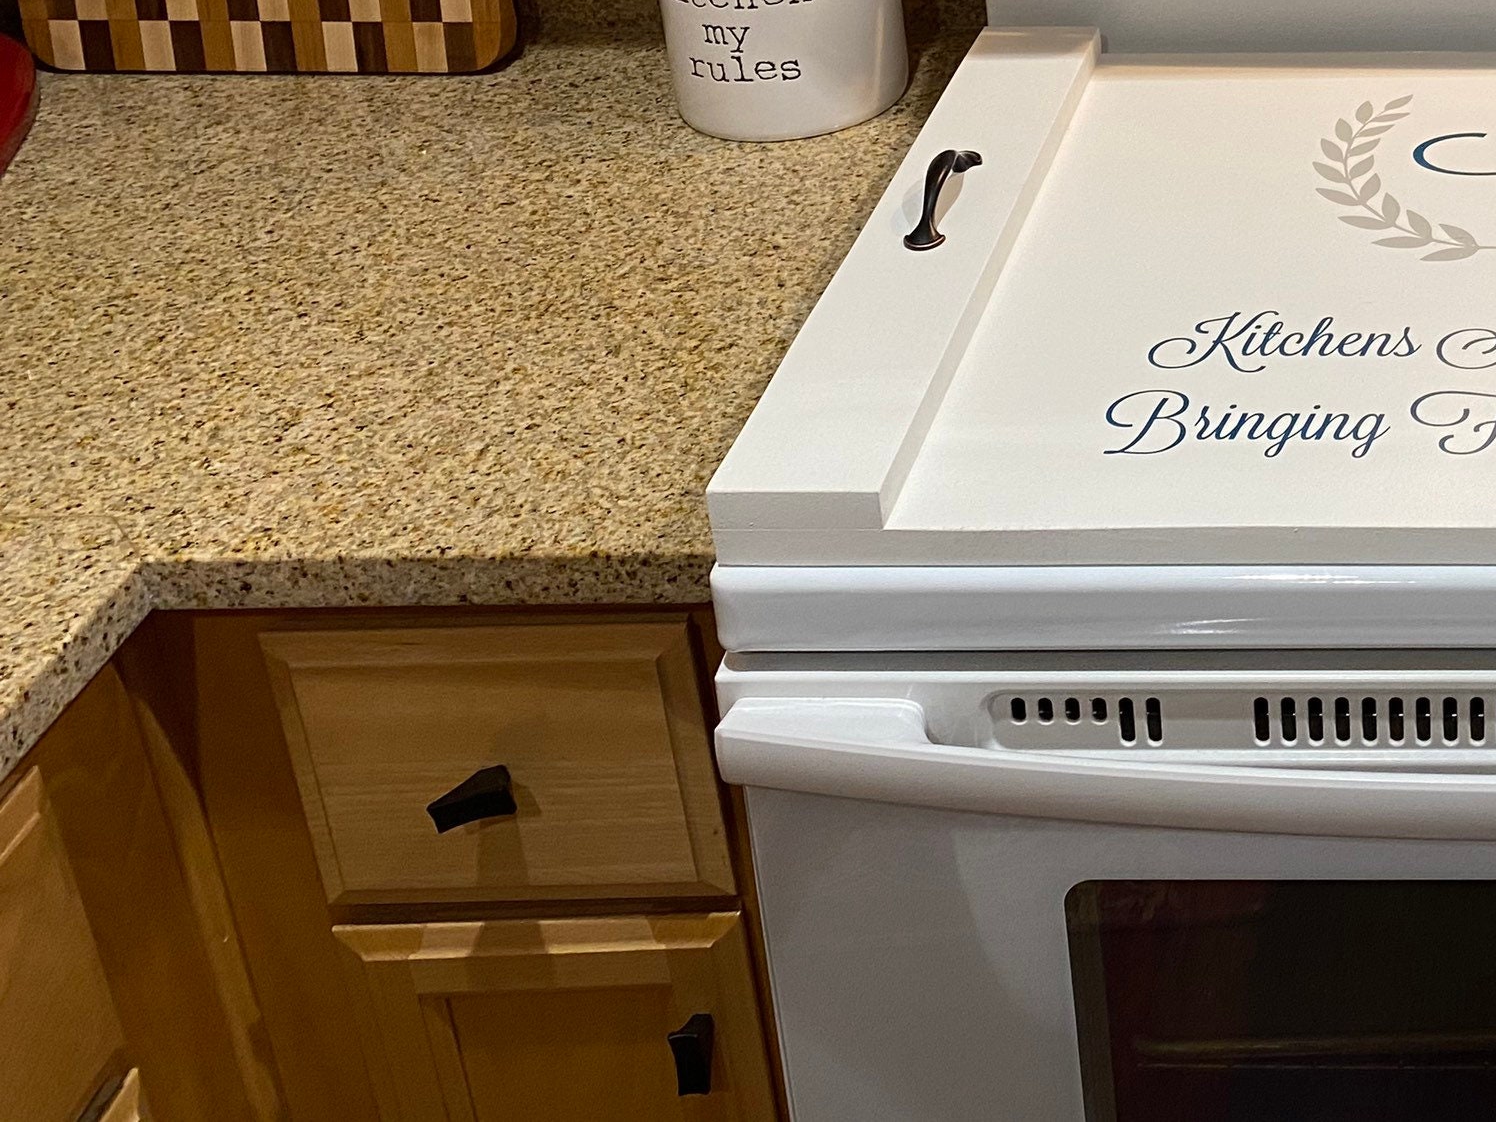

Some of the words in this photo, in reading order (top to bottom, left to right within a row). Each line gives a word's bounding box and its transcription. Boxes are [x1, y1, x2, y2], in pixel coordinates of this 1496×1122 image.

[702, 24, 750, 53] my
[689, 55, 801, 82] rules
[1147, 310, 1422, 373] Kitchens
[1103, 389, 1391, 459] Bringing
